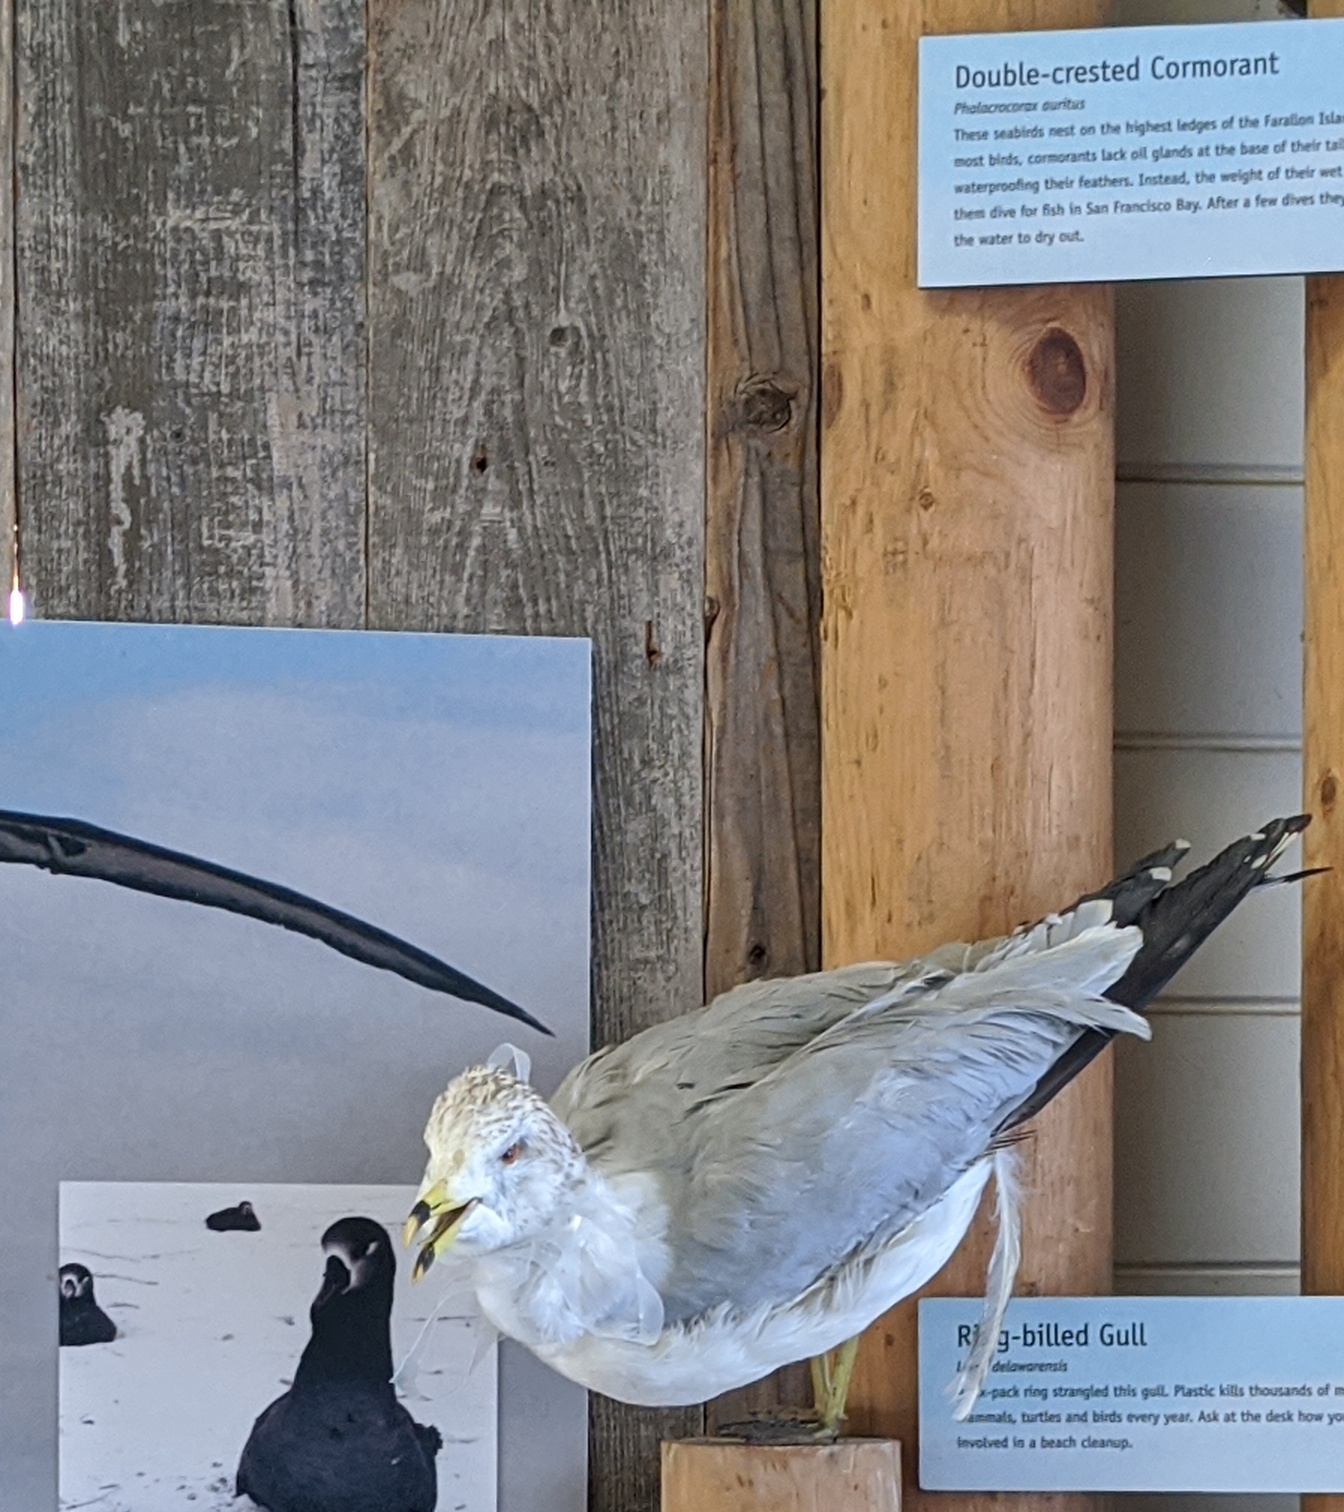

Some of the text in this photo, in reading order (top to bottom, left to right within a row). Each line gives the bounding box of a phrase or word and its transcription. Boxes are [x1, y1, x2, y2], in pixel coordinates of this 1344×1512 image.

[956, 52, 1279, 88] Double-crested Cormorant
[954, 178, 1040, 195] waterproofing
[1044, 176, 1074, 190] their
[1195, 171, 1216, 184] the
[1220, 169, 1263, 185] weight
[1267, 167, 1281, 181] of
[1285, 165, 1315, 180] their
[1319, 165, 1342, 178] wet
[954, 234, 974, 247] the
[979, 233, 1013, 245] water
[1017, 232, 1031, 244] to
[1035, 231, 1055, 246] dry
[1100, 1322, 1147, 1346] Gull
[957, 1435, 1133, 1450] involved in a beach cleanup.
